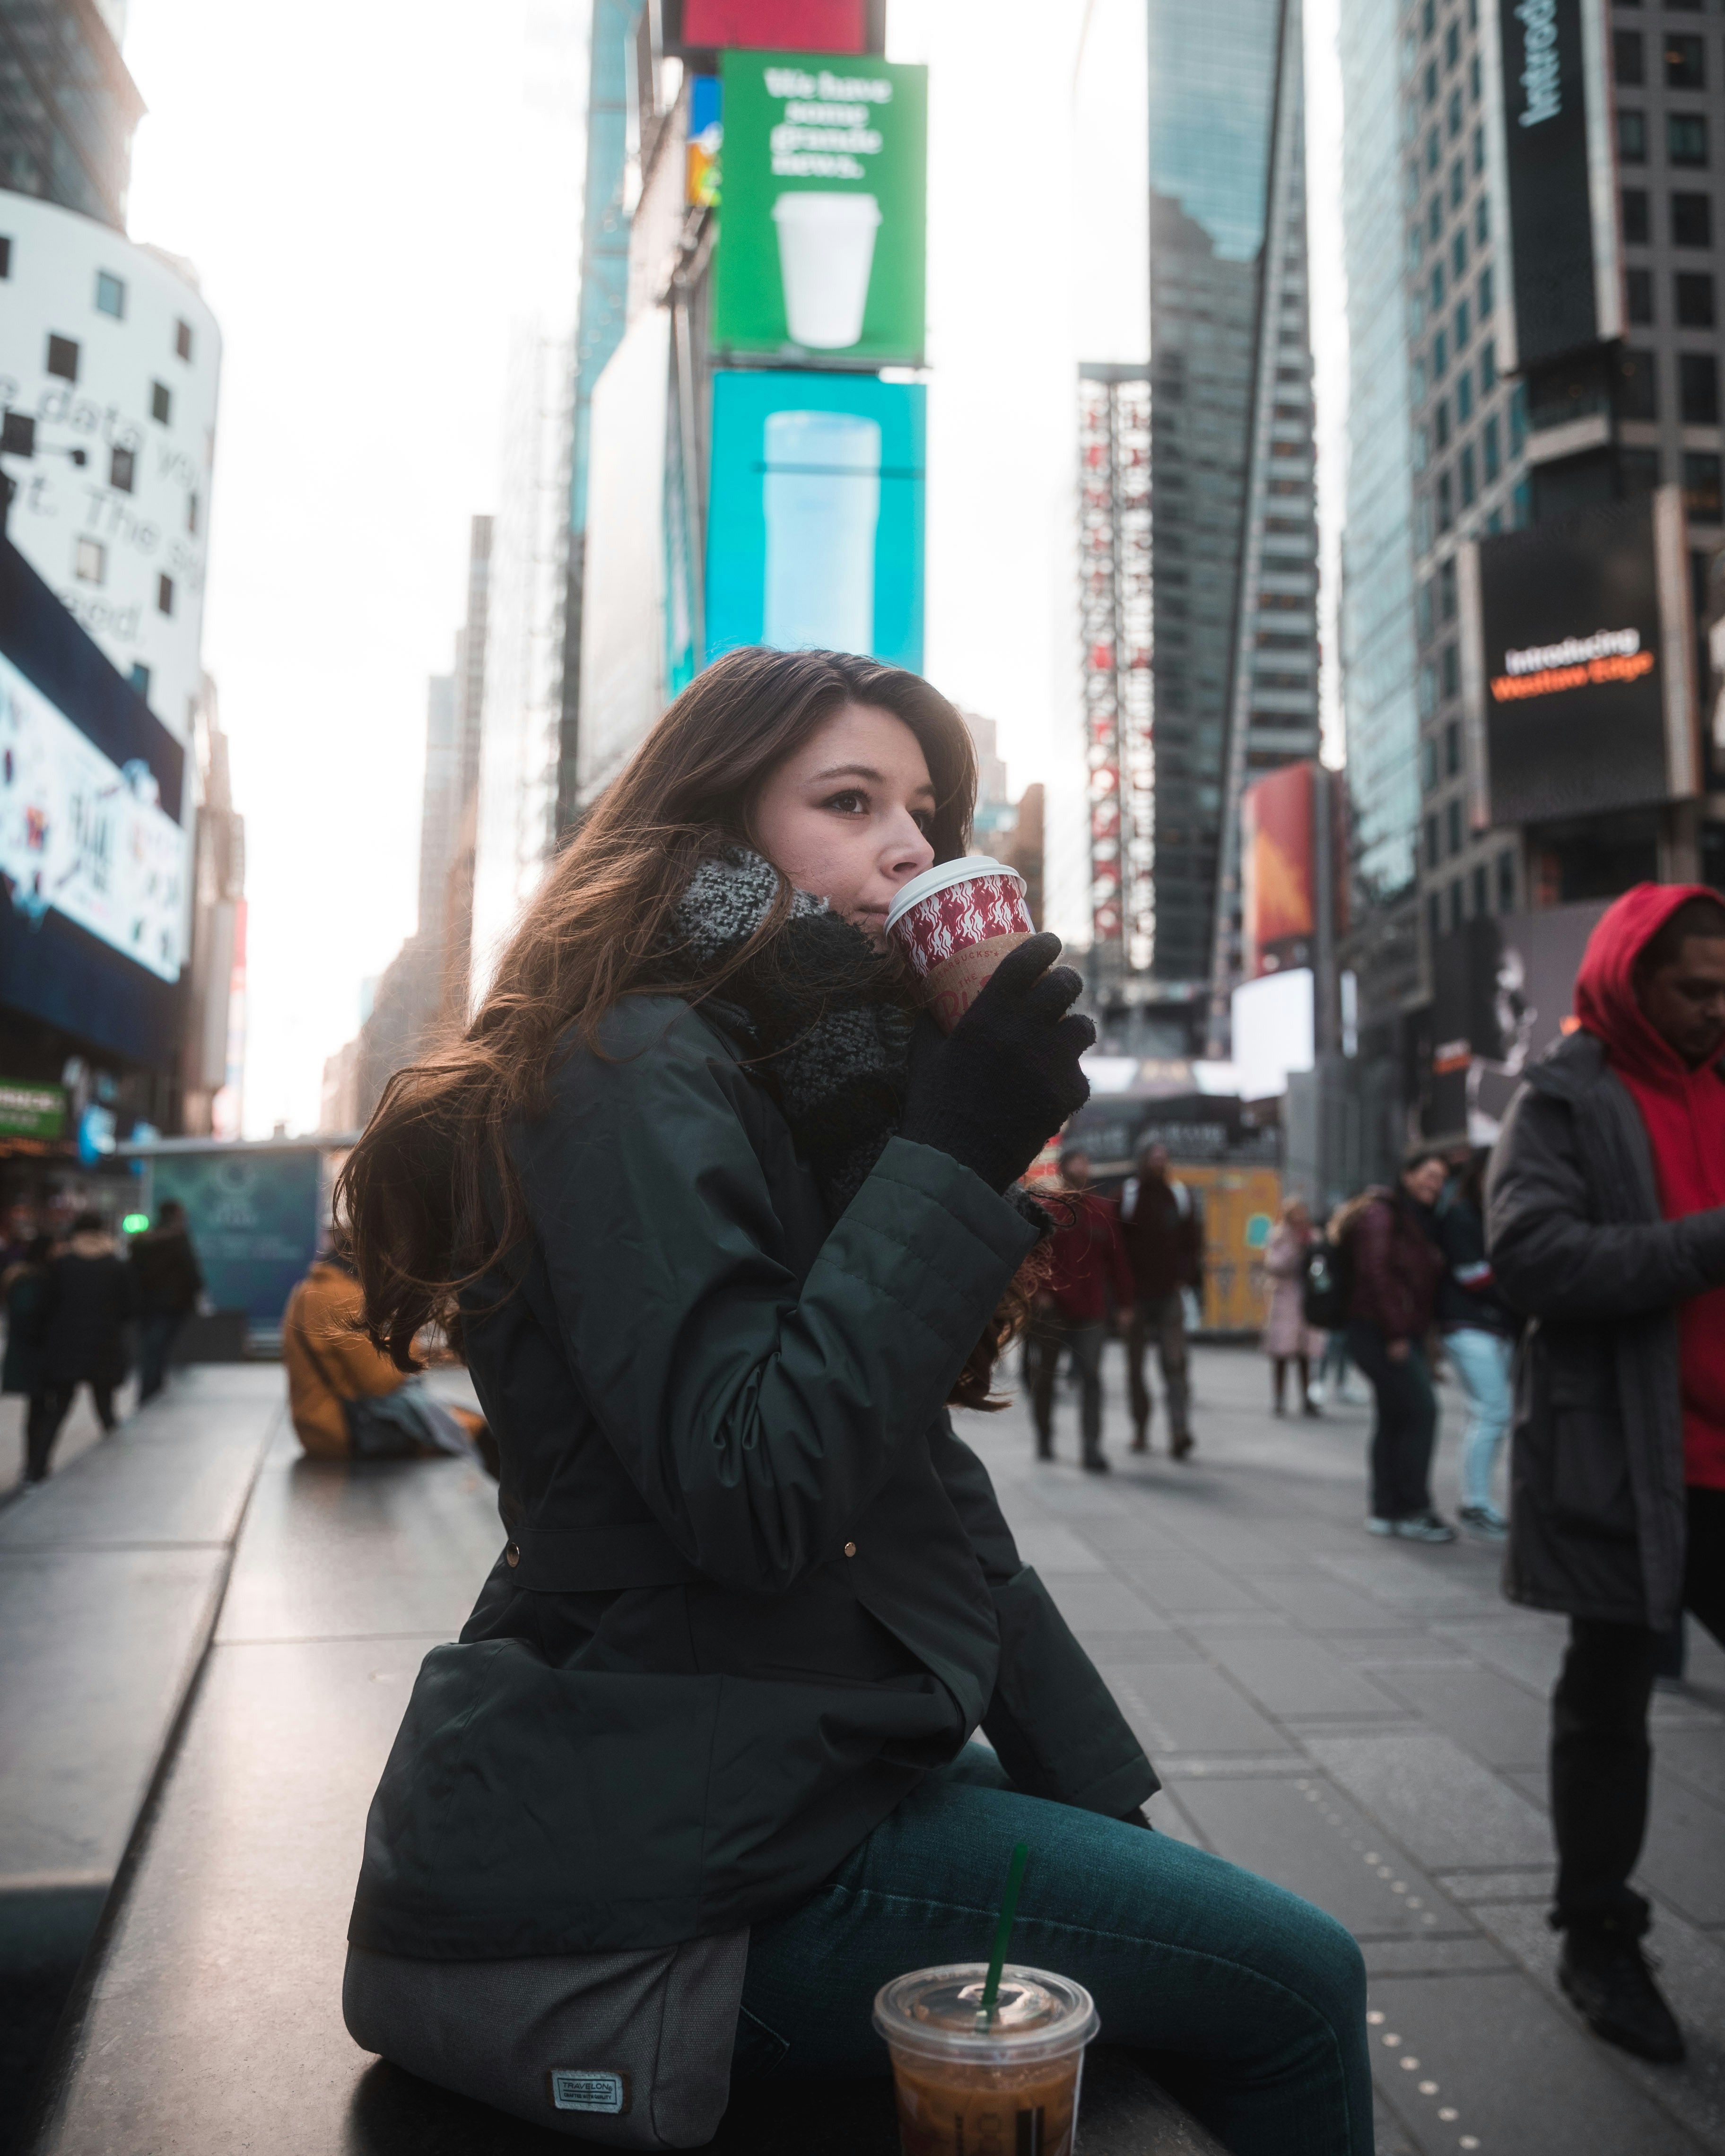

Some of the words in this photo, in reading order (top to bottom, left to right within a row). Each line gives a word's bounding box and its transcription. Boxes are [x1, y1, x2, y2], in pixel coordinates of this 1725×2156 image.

[765, 68, 817, 99] We
[818, 70, 892, 103] have
[785, 100, 869, 128] some
[770, 123, 883, 154] grande
[1505, 627, 1640, 675] Introducing
[958, 973, 977, 987] THE
